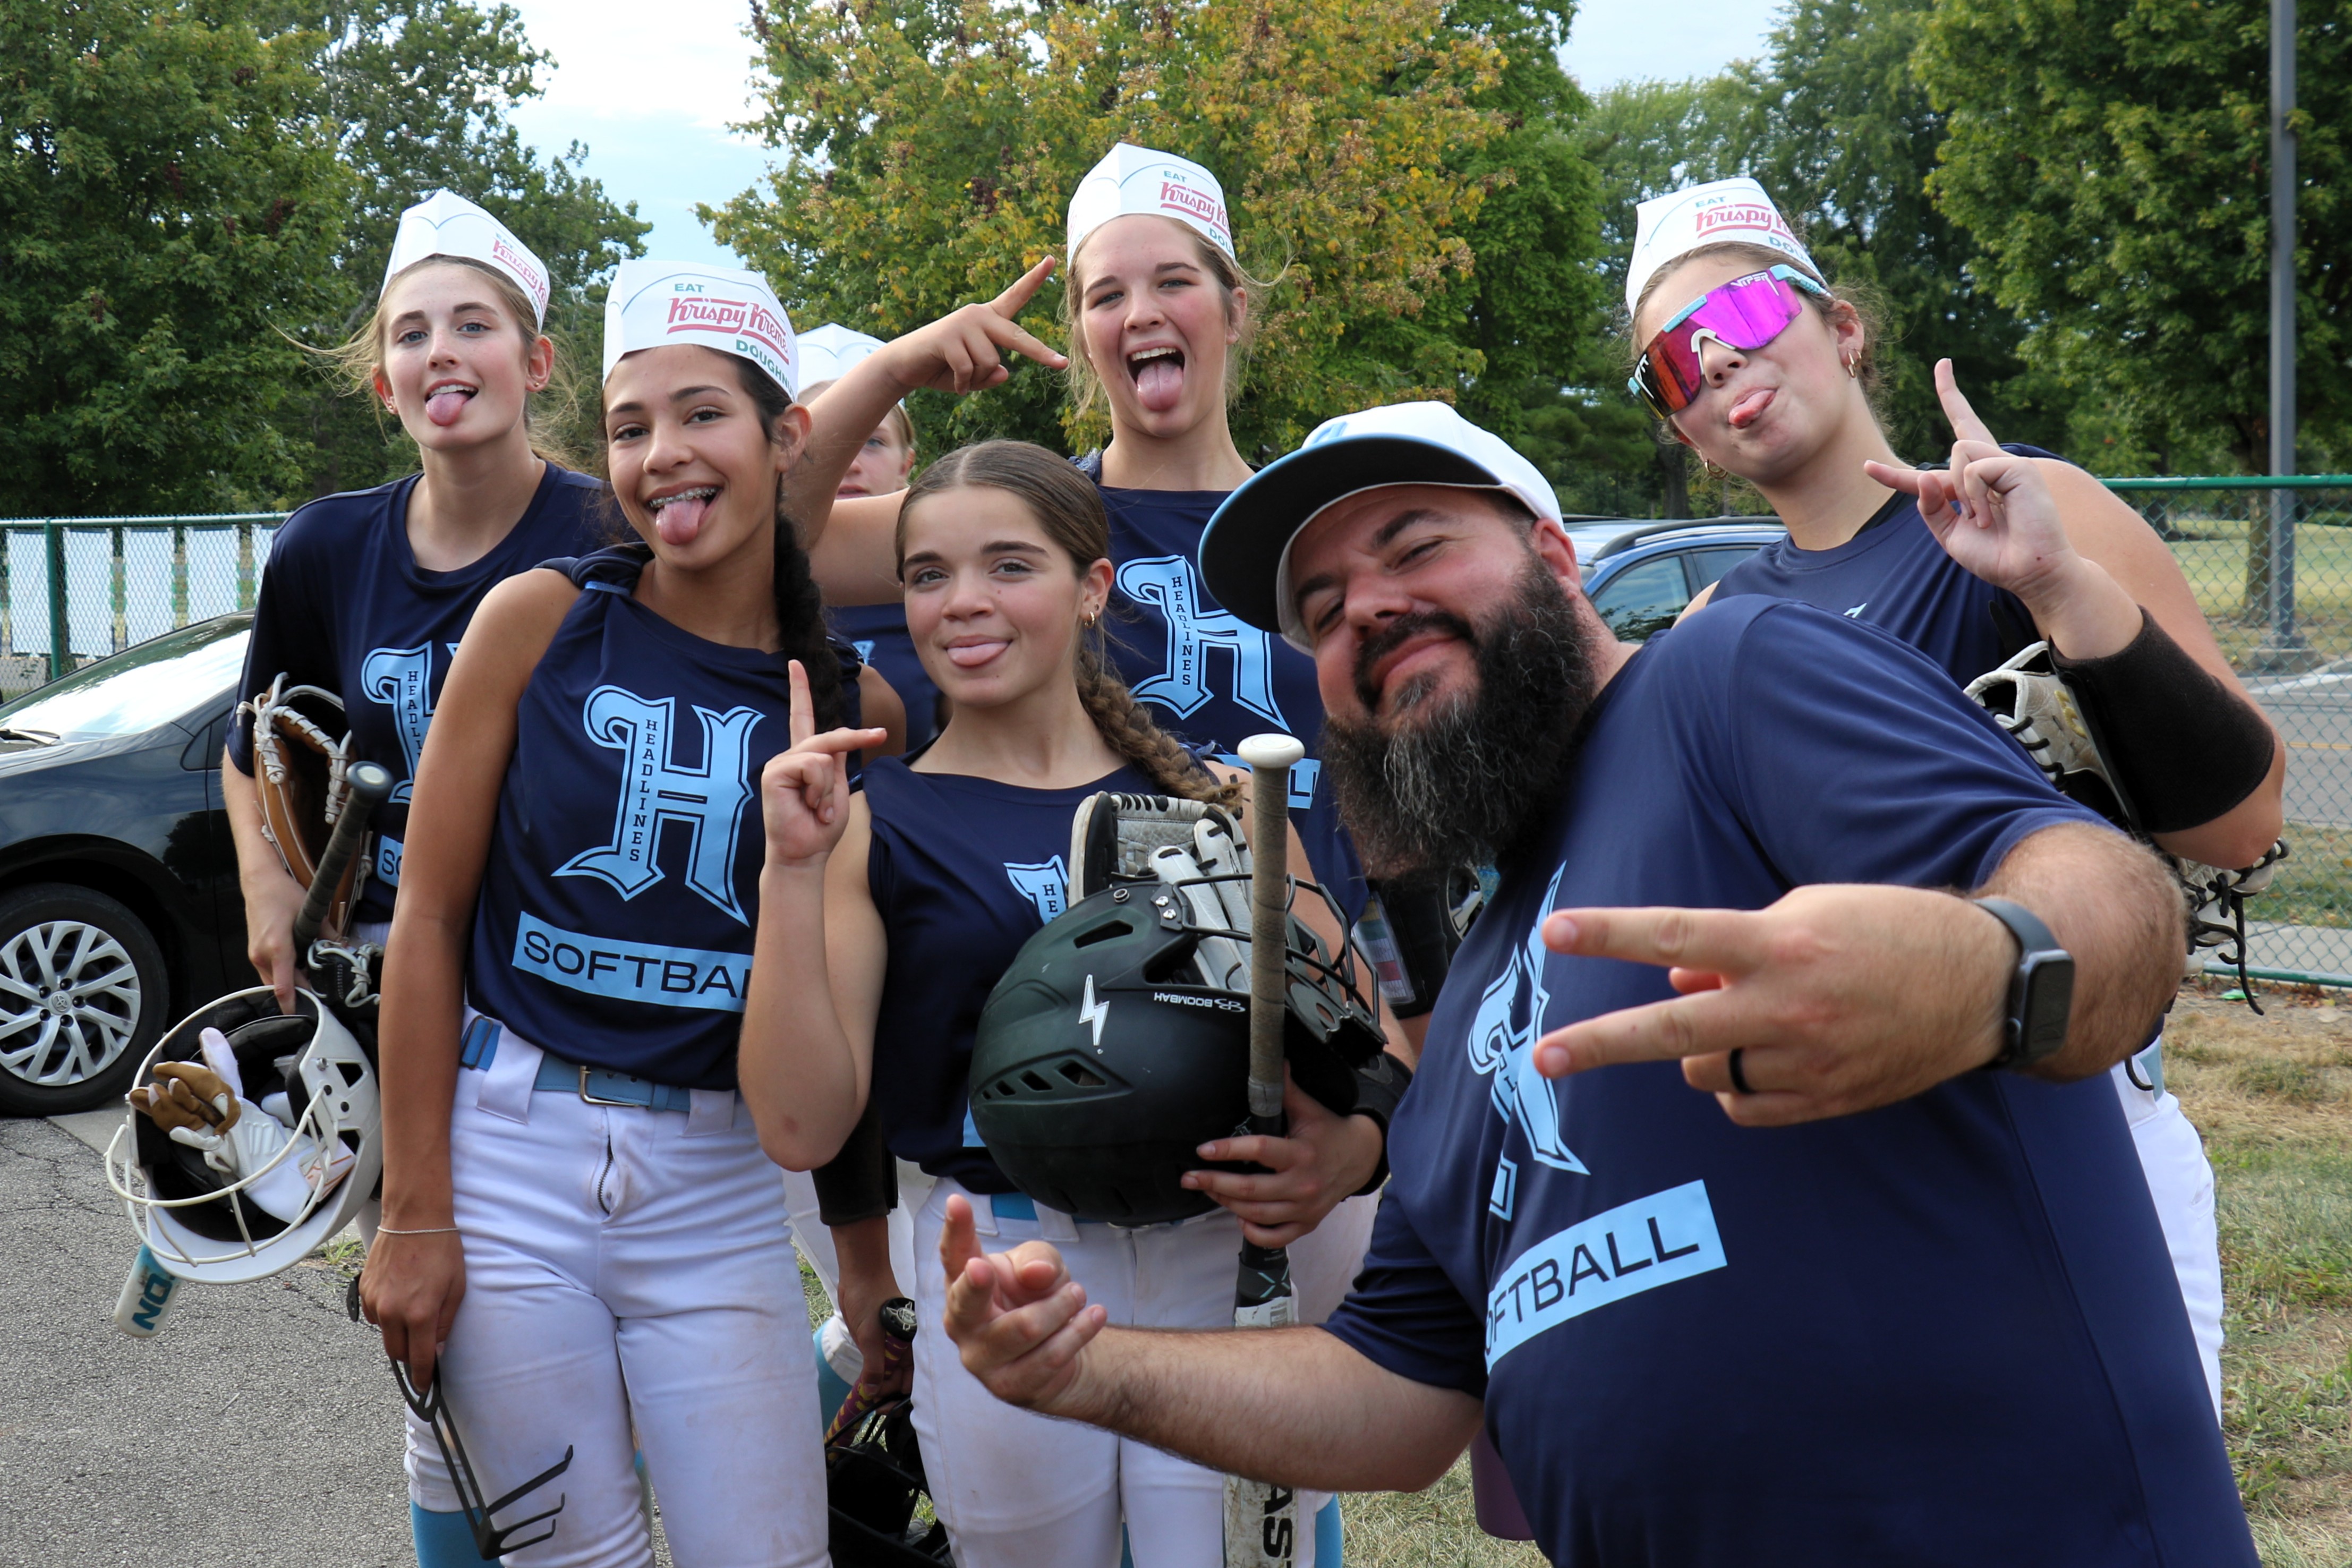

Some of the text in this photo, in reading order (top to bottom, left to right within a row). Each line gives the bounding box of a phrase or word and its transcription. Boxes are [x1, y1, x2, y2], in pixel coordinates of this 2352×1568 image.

[1163, 170, 1187, 182] EAT
[1160, 181, 1215, 223] Krispy
[1693, 203, 1772, 238] Krispy
[1695, 196, 1726, 208] EAT
[674, 283, 705, 293] EAT
[1730, 271, 1779, 296] VIPER
[667, 296, 789, 363] Krispy Kreme
[1171, 576, 1192, 686] HEADLINES
[629, 719, 658, 863] HEADLINES
[523, 930, 752, 1001] SOFTBA
[1154, 992, 1213, 1008] BOOMBAH
[132, 1273, 176, 1331] ON
[1485, 1216, 1700, 1357] OFTBALL
